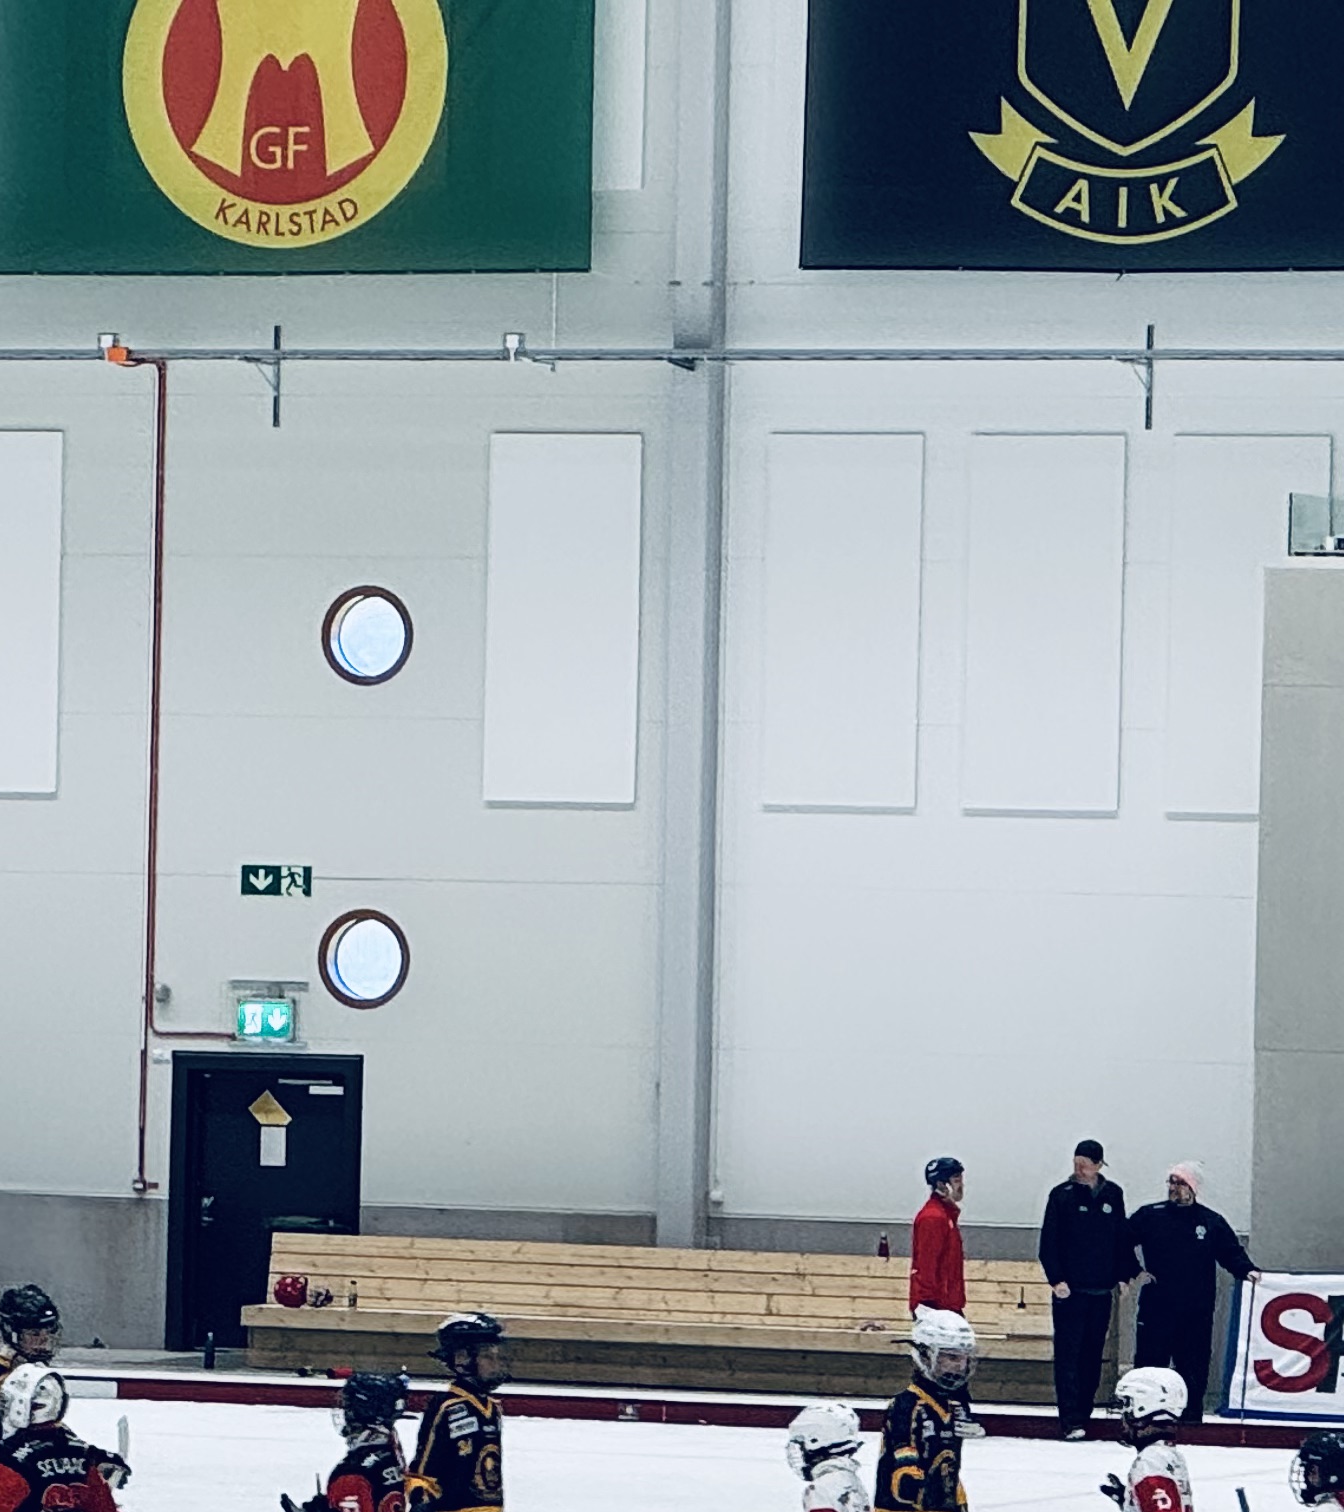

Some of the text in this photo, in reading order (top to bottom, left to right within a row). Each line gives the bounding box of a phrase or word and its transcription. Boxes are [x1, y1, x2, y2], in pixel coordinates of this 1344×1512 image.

[249, 127, 310, 170] GF
[215, 197, 359, 237] KARLSTAD
[1053, 176, 1188, 229] AIK
